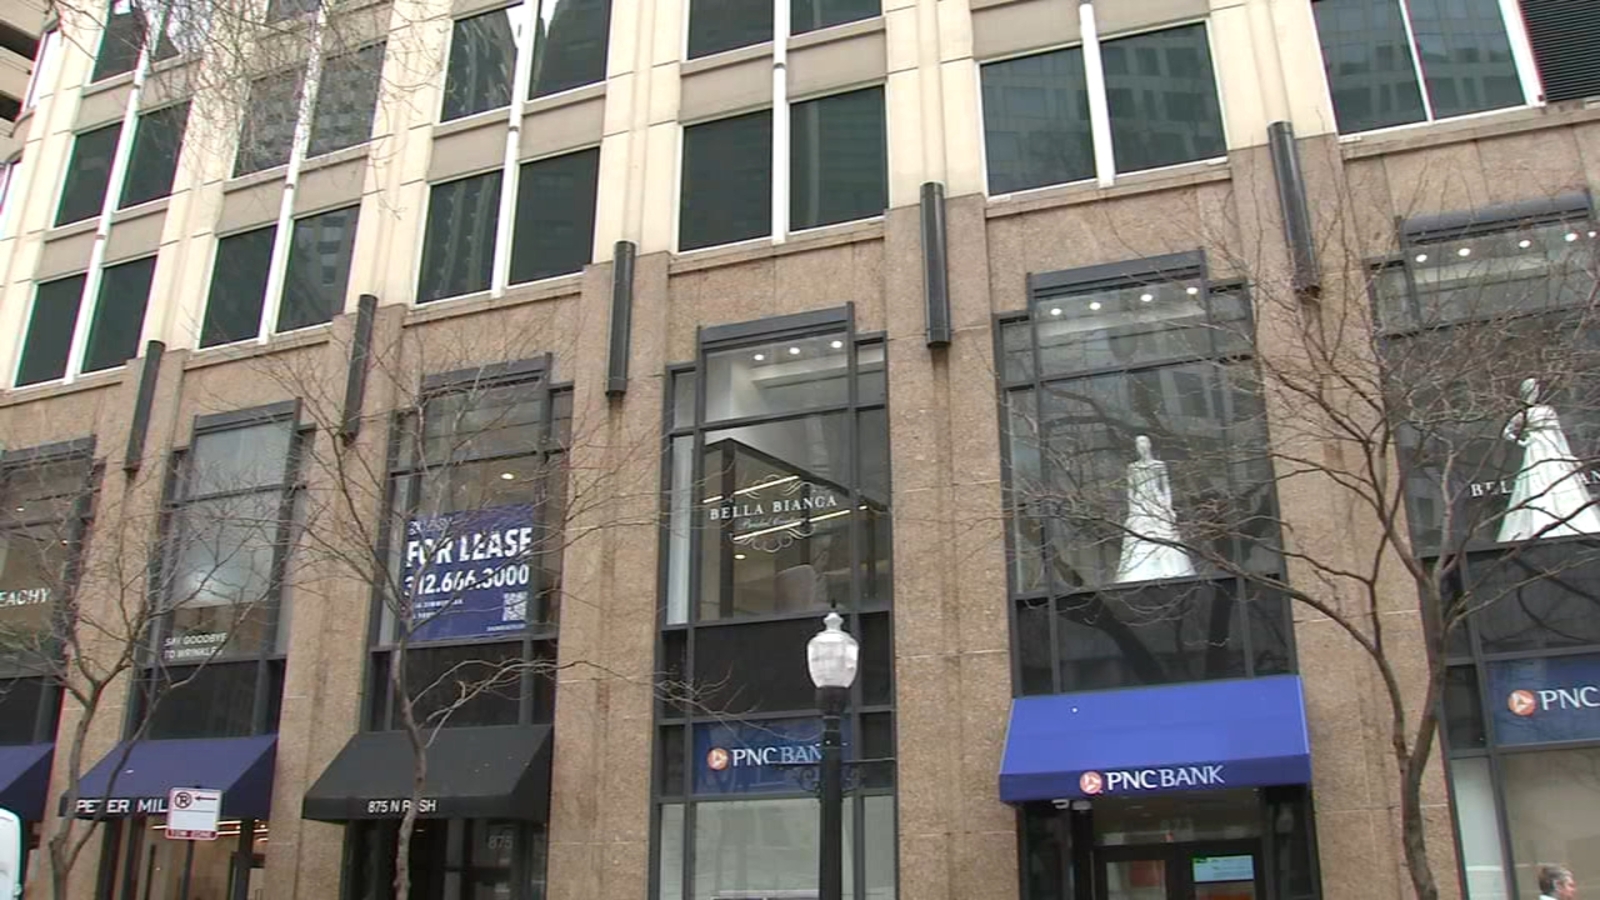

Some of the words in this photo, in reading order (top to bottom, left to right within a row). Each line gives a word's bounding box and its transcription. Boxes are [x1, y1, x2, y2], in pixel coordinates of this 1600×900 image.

[710, 504, 764, 520] BELLA
[772, 495, 838, 513] BIANCA
[459, 527, 533, 562] LEASE
[183, 632, 228, 645] GOODBYE
[1537, 686, 1600, 711] PNC
[730, 747, 778, 767] PNC
[779, 744, 822, 763] BAN
[1105, 769, 1157, 791] PNC
[1158, 765, 1226, 787] BANK
[137, 799, 168, 814] MIL
[367, 800, 388, 813] 875
[390, 799, 400, 812] N
[402, 798, 437, 812] RSH
